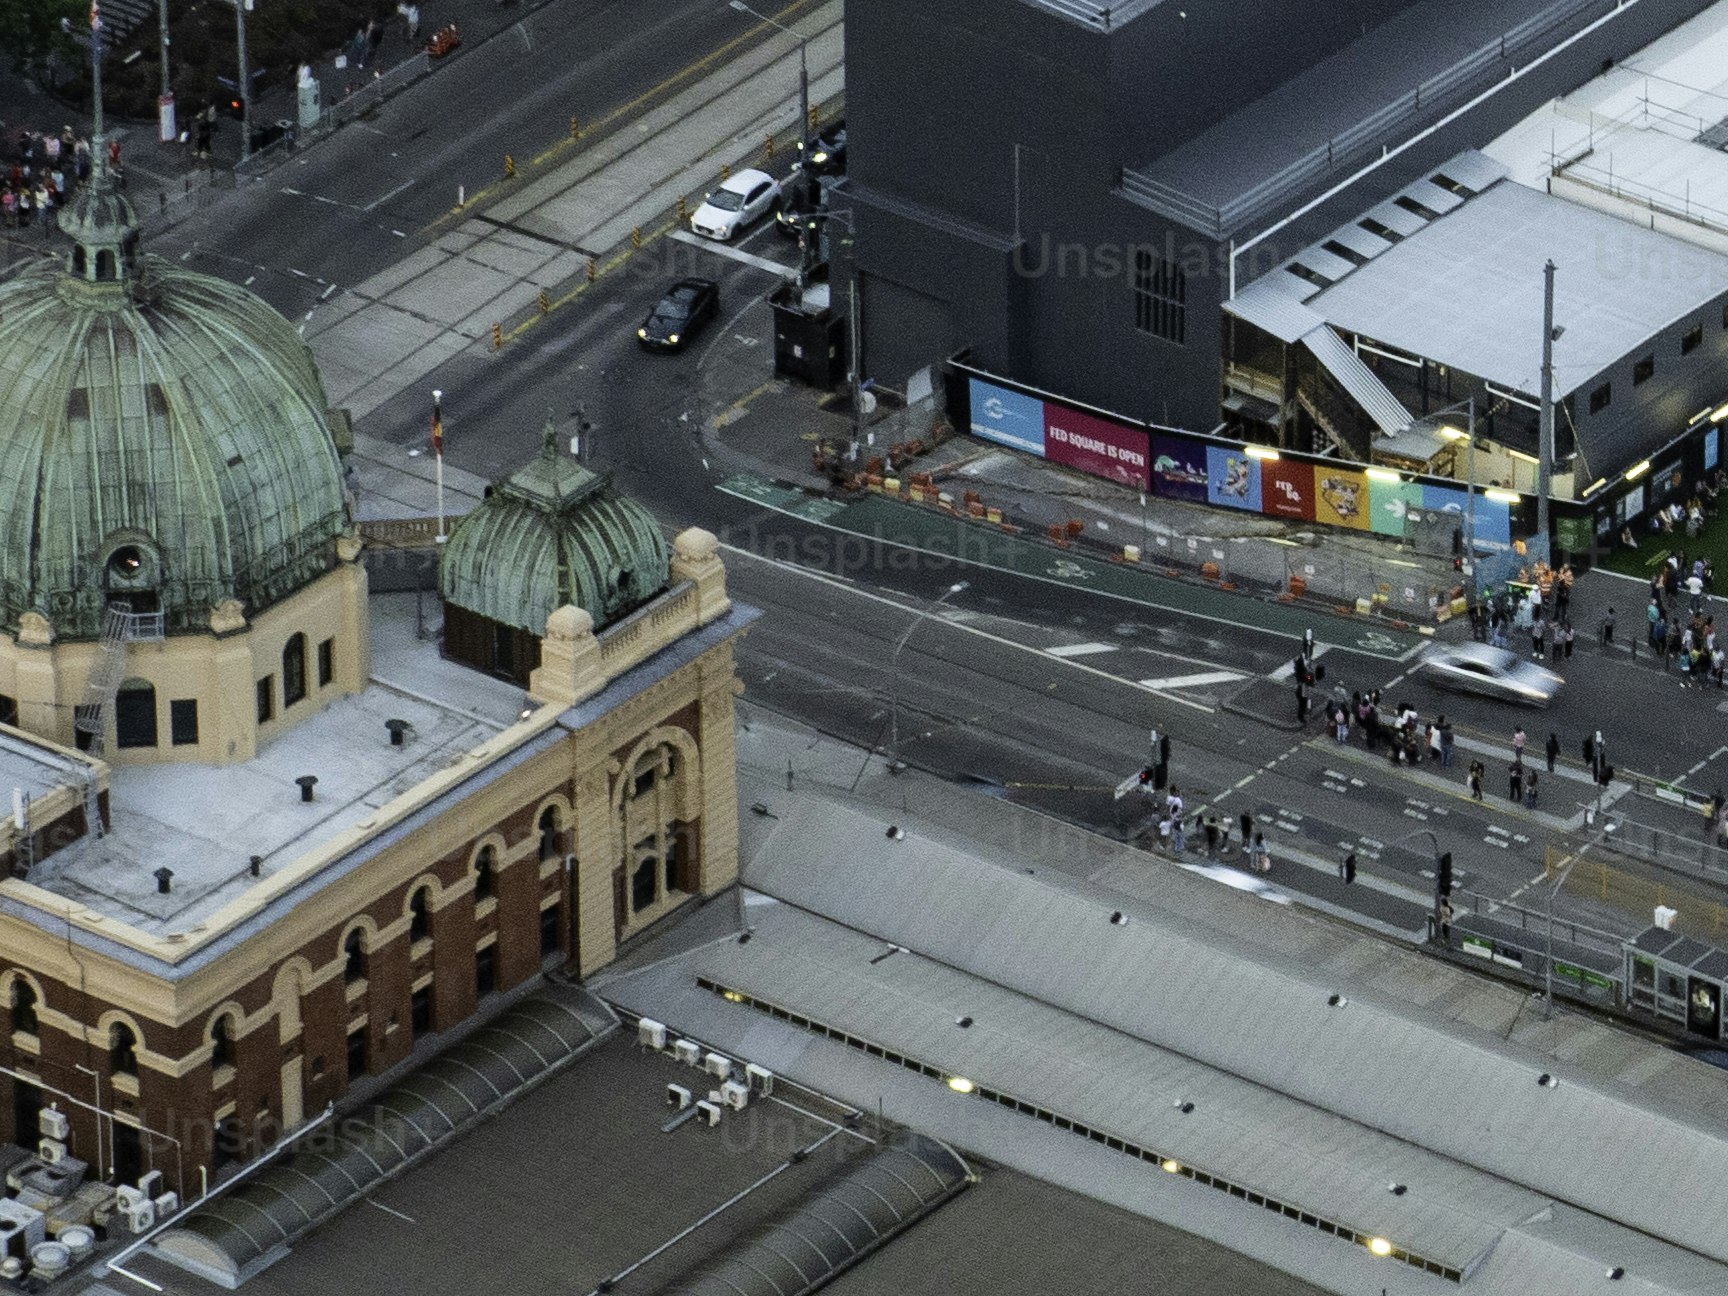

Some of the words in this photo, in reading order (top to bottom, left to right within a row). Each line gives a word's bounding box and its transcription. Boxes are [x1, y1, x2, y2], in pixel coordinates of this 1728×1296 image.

[1049, 425, 1068, 443] FED
[1068, 431, 1107, 456] SQUARE
[1107, 444, 1118, 458] IS
[1118, 447, 1145, 467] OPEN
